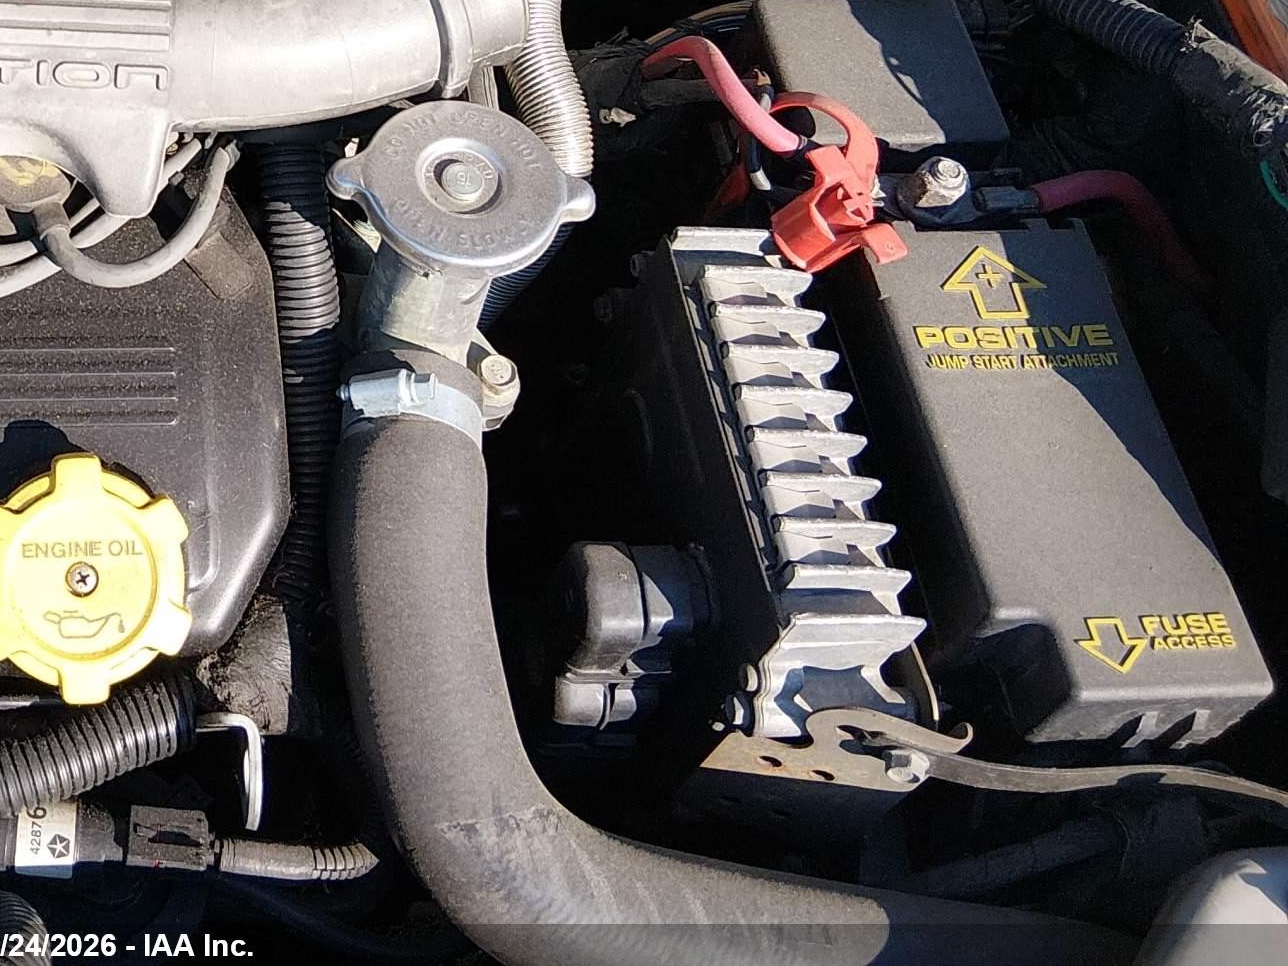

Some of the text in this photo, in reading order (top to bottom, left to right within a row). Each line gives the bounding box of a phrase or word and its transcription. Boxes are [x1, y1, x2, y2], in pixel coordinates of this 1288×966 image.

[914, 324, 1115, 349] POSITIVE
[927, 352, 1120, 370] JUMP START ATTACHMENT
[21, 539, 144, 559] ENGINE OIL
[1139, 612, 1232, 635] FUSE
[1152, 635, 1237, 651] ACCESS
